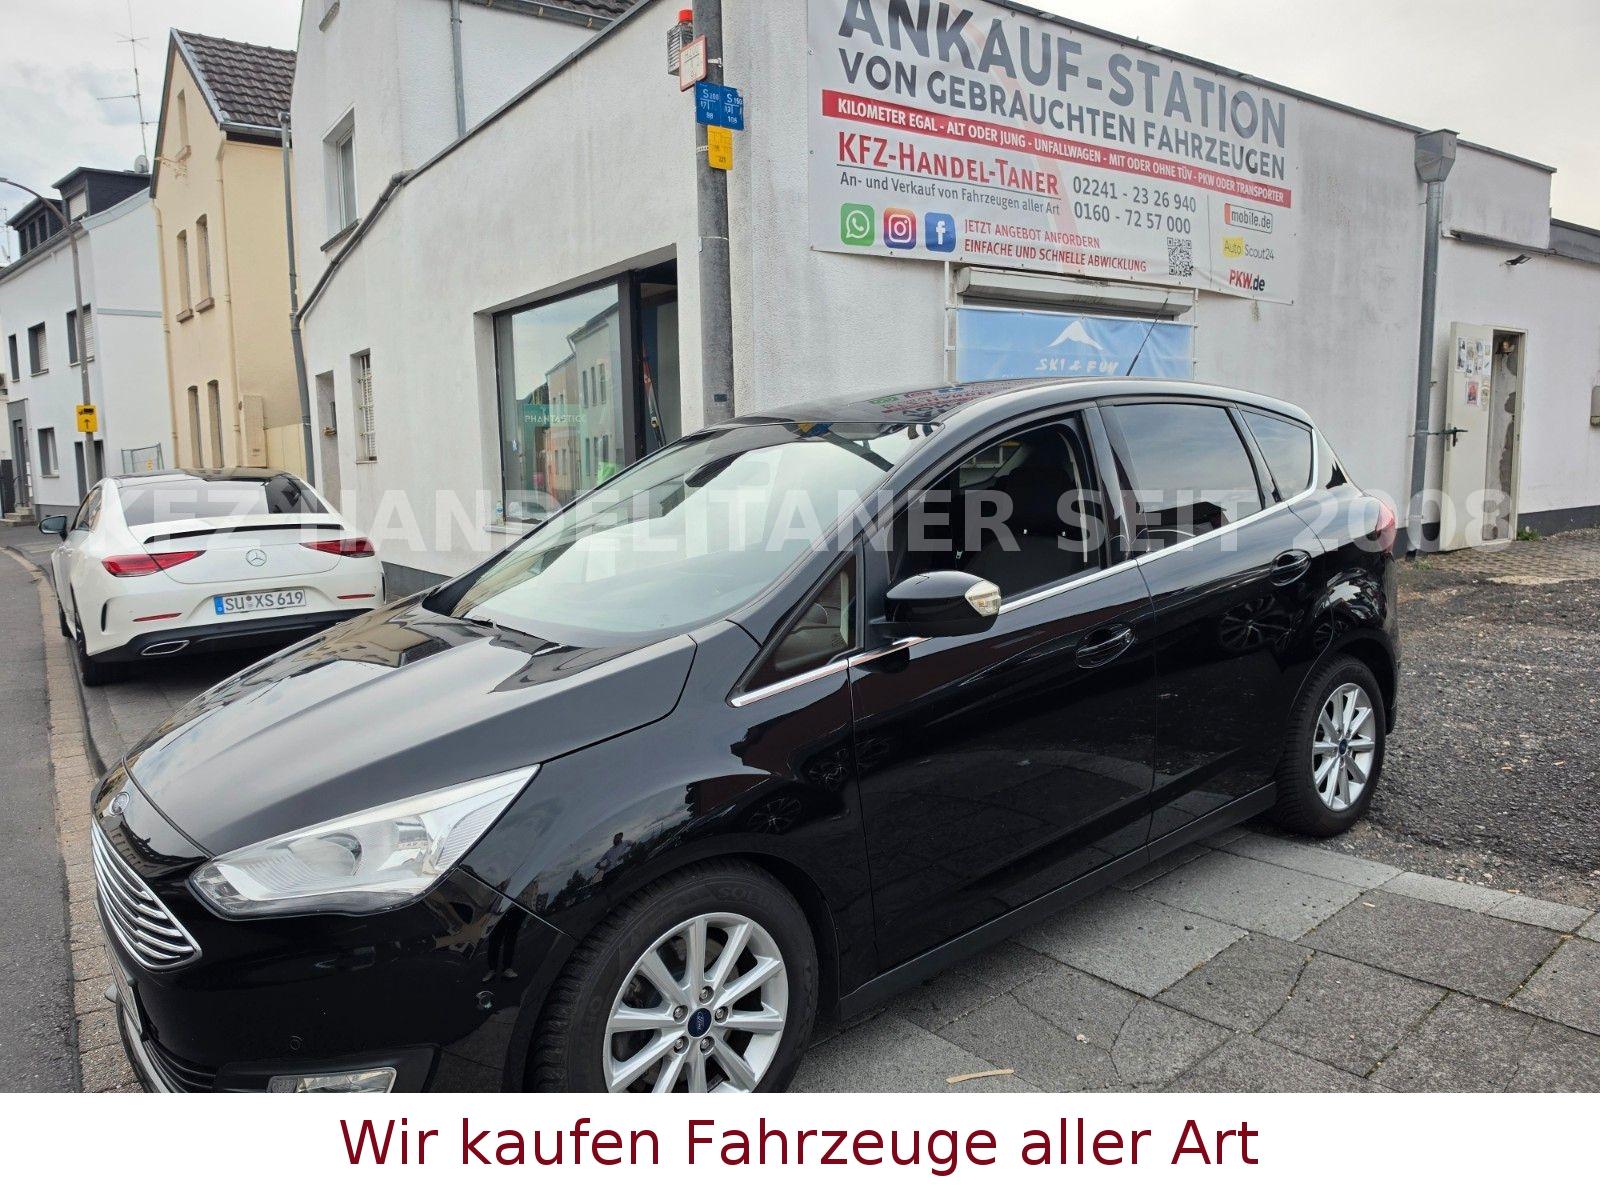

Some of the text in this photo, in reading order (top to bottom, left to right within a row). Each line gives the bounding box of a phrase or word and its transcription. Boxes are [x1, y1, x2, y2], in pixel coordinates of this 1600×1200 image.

[838, 0, 1286, 148] ANKAUF-STATION
[838, 48, 1285, 180] VON GEBRAUCHTEN FAHRZEUGEN
[838, 98, 906, 126] KILOMETER
[909, 113, 938, 132] EGAL
[947, 121, 966, 136] ALT
[968, 125, 998, 143] ODER
[1000, 132, 1026, 148] JUNG
[1034, 139, 1101, 163] UNFALLWAGEN
[1109, 153, 1125, 167] MIT
[1127, 157, 1151, 173] ODER
[1153, 162, 1176, 178] OHNE
[1175, 164, 1193, 181] TÜV
[1198, 173, 1215, 187] PKW
[1216, 178, 1235, 192] ODER
[1236, 181, 1284, 203] TRANSPORTER
[840, 171, 1060, 216] An- und Verkauf von Fahrzeugen aller Art
[1073, 175, 1118, 200] 02241
[1133, 186, 1149, 205] 23
[1154, 190, 1170, 208] 26
[1174, 193, 1196, 213] 940
[964, 218, 1100, 248] JETZT ANGEBOT ANFORDERN
[1074, 201, 1110, 223] 0160
[1125, 209, 1142, 228] 72
[1146, 213, 1162, 231] 57
[1166, 215, 1191, 235] 000
[1231, 210, 1271, 229] mobile.de
[964, 240, 1147, 273] EINFACHE UND SCHNELLE ABWICKLUNG
[1229, 269, 1266, 291] PKW.de
[1035, 357, 1066, 372] SKI
[1086, 359, 1119, 375] FUN
[225, 591, 303, 611] SU XS 619
